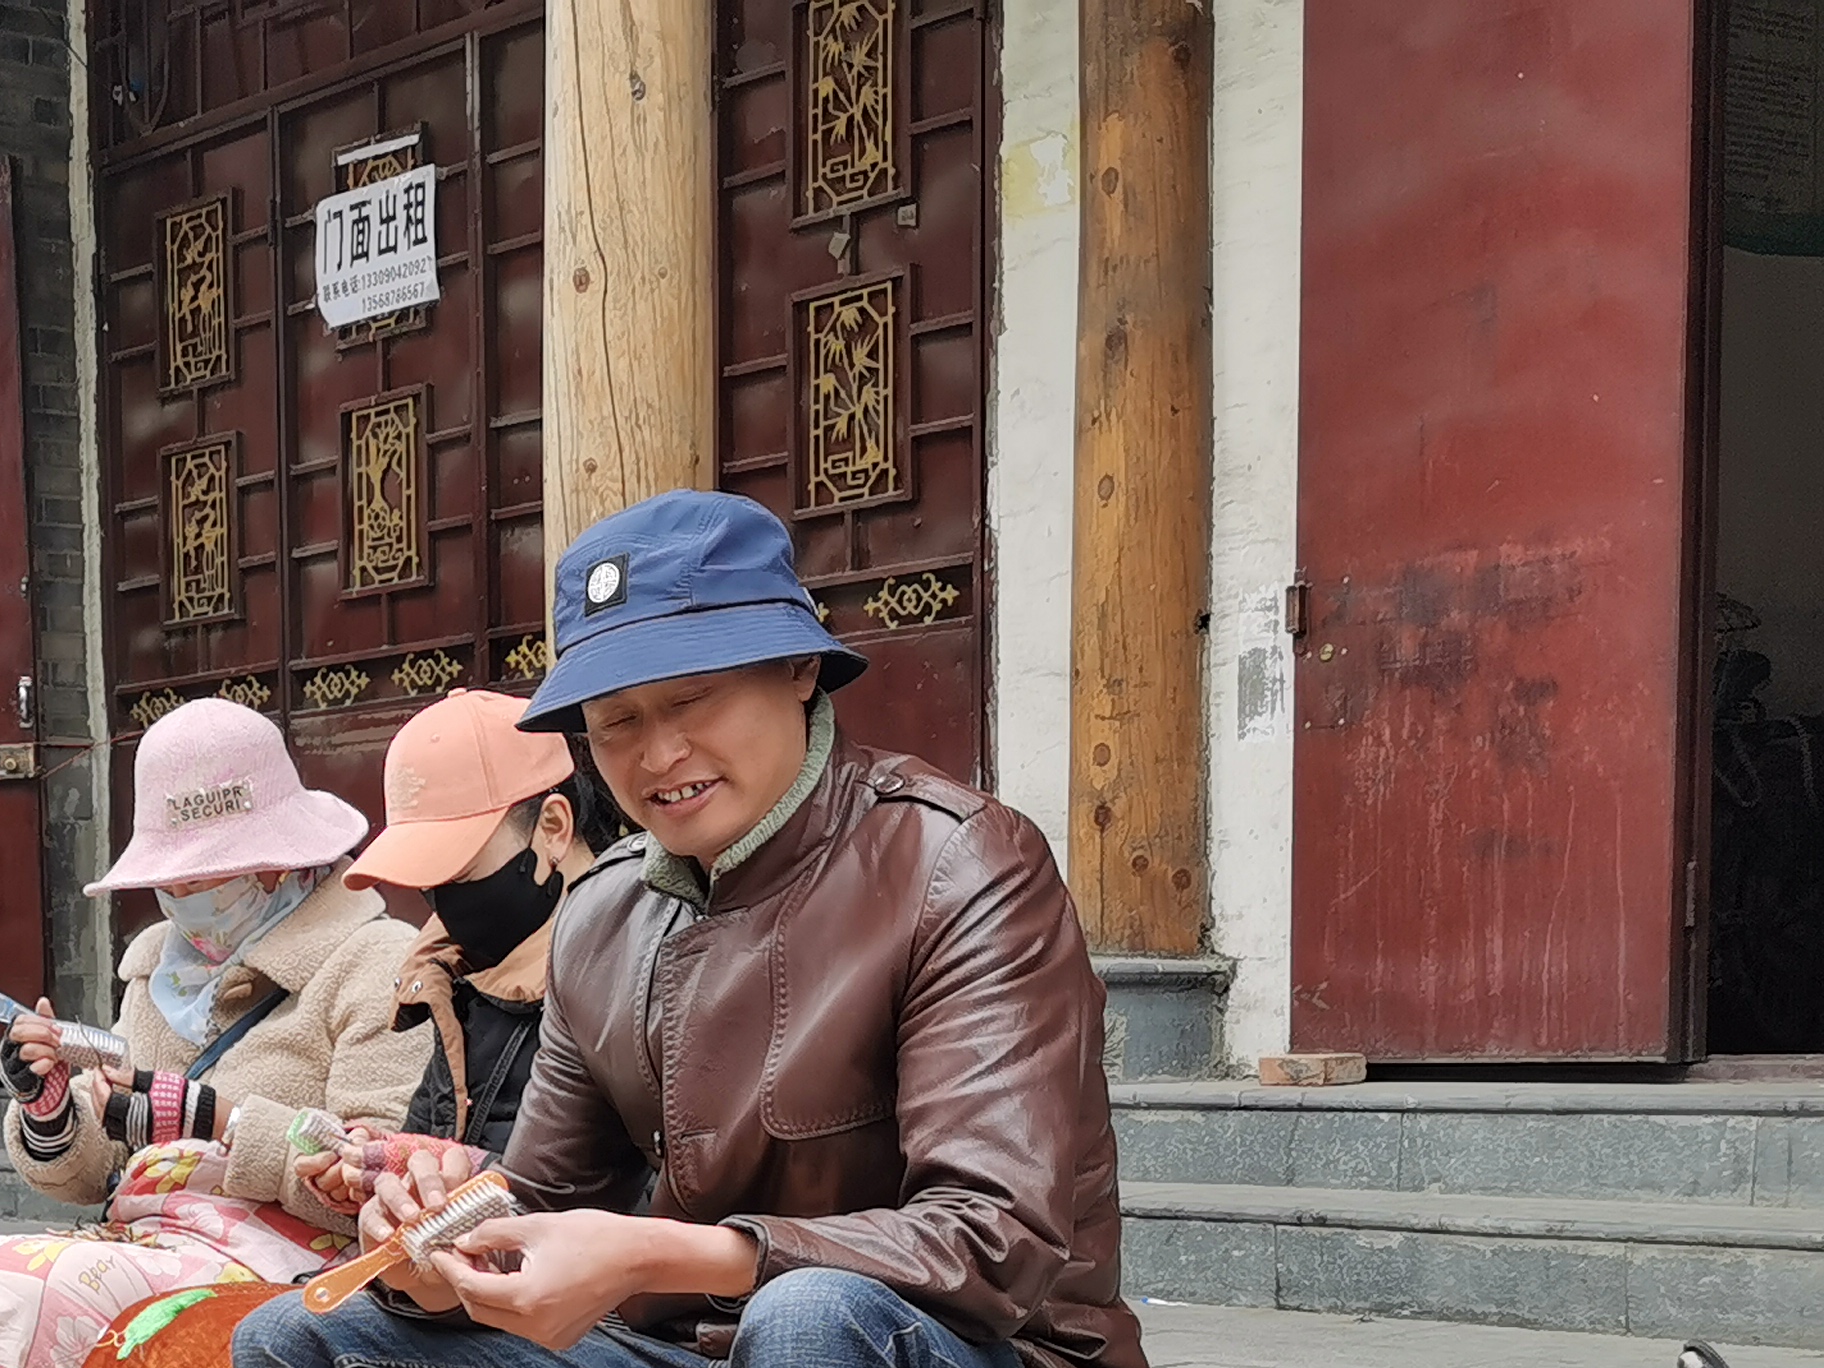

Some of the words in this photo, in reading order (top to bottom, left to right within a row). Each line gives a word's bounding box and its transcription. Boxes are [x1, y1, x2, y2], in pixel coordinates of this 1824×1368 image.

[323, 180, 428, 275] 门面出租
[180, 798, 241, 822] SECURI
